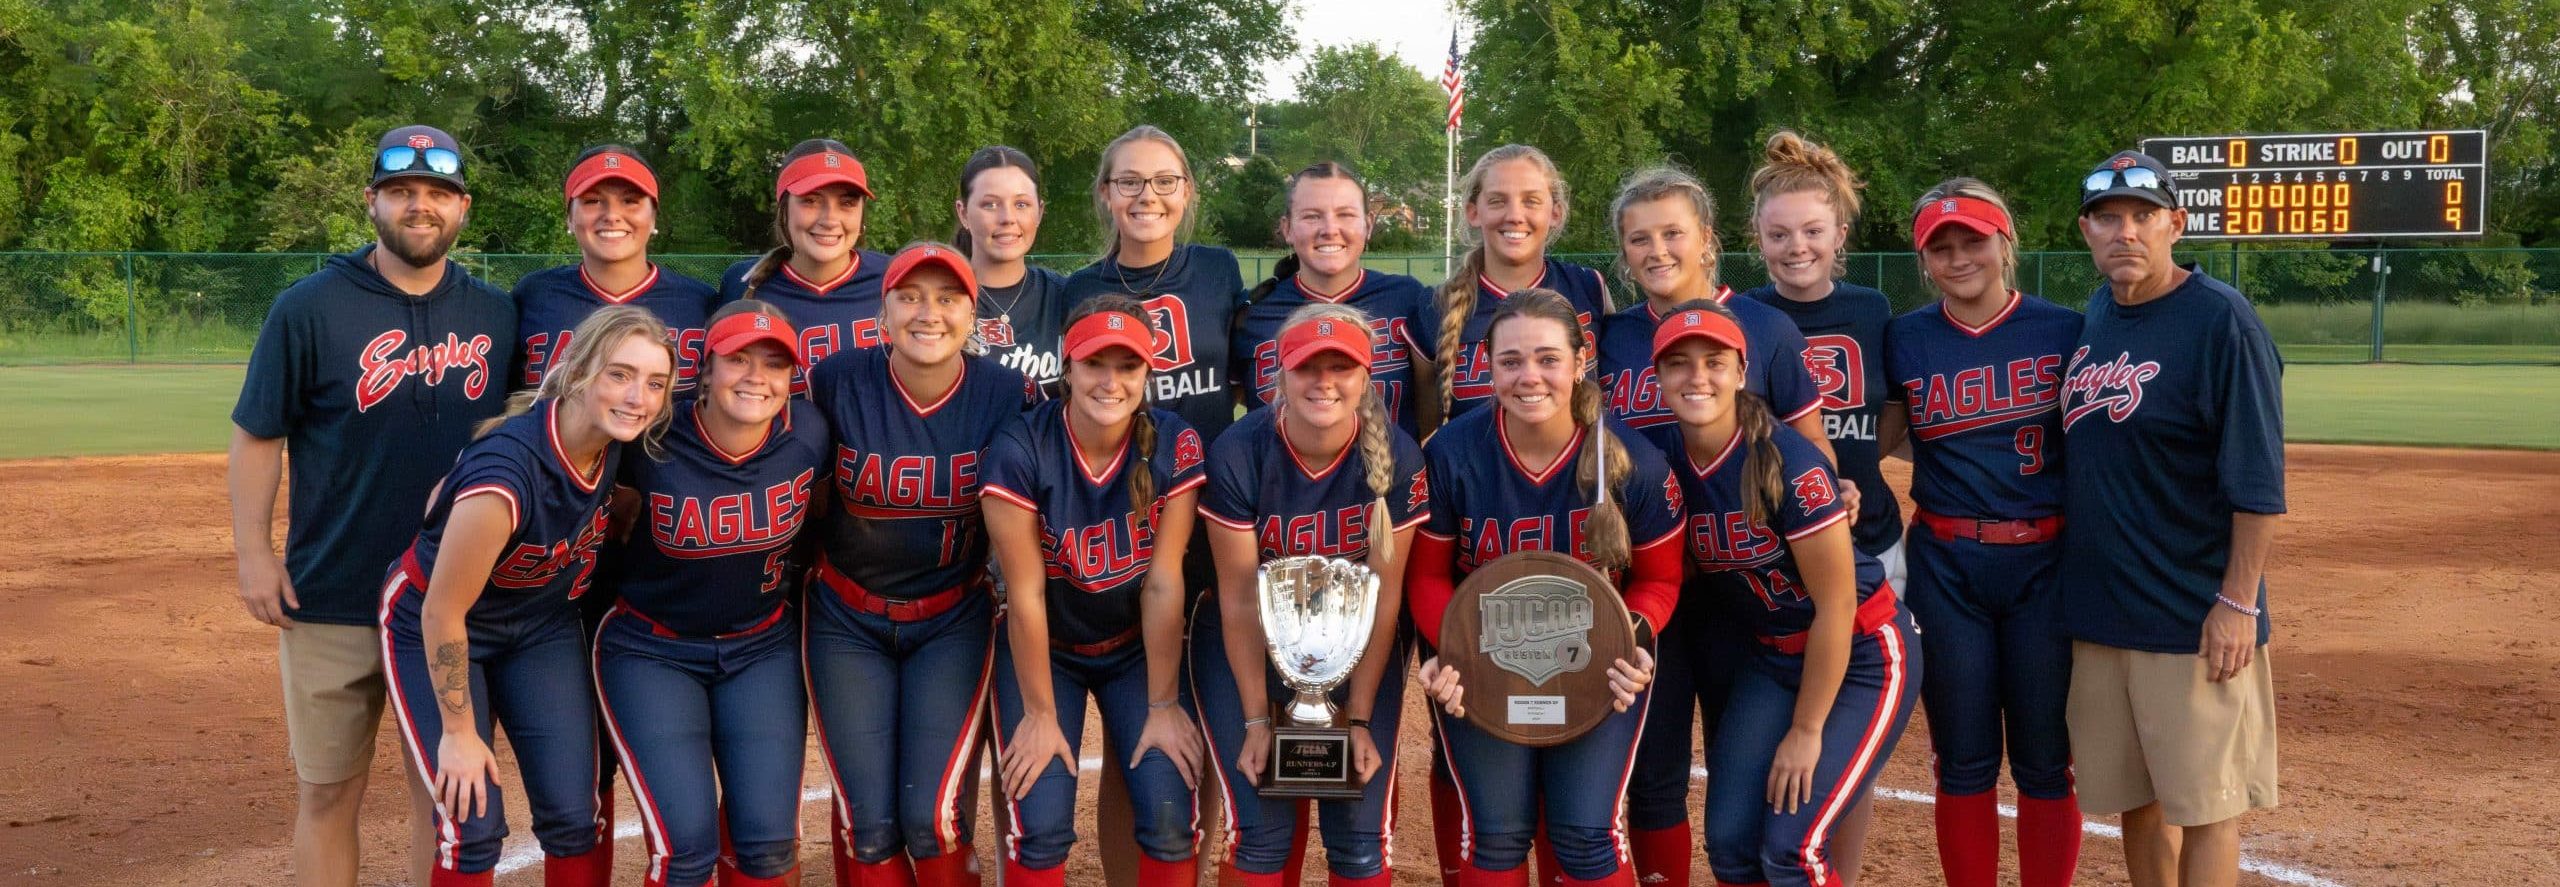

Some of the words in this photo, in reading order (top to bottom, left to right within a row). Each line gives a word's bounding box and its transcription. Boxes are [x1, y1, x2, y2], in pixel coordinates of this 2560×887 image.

[2172, 145, 2224, 164] BALL
[2229, 140, 2246, 167] 0
[2261, 142, 2335, 162] STRIKE
[2339, 137, 2357, 165] 0
[2381, 140, 2426, 159] OUT
[2430, 135, 2449, 163] 0
[2176, 188, 2222, 207] ITOR
[2231, 173, 2238, 184] 1
[2251, 173, 2260, 183] 2
[2273, 172, 2282, 183] 3
[2294, 172, 2303, 182] 4
[2316, 172, 2324, 181] 5
[2338, 171, 2346, 181] 6
[2360, 171, 2369, 181] 7
[2381, 170, 2390, 181] 8
[2403, 170, 2412, 180] 9
[2426, 169, 2464, 180] TOTAL
[2187, 212, 2221, 231] ME
[2446, 208, 2461, 230] 9
[356, 329, 492, 413] Eagles
[1146, 367, 1221, 402] BALL
[1903, 354, 2061, 425] EAGLES
[2014, 424, 2044, 476] 9
[835, 444, 987, 507] EAGLE
[650, 467, 815, 547] EAGLES
[1461, 508, 1592, 566] EAGLE
[1690, 511, 1780, 560] GLES
[1484, 598, 1590, 647] NJCAA
[1567, 646, 1579, 663] 7
